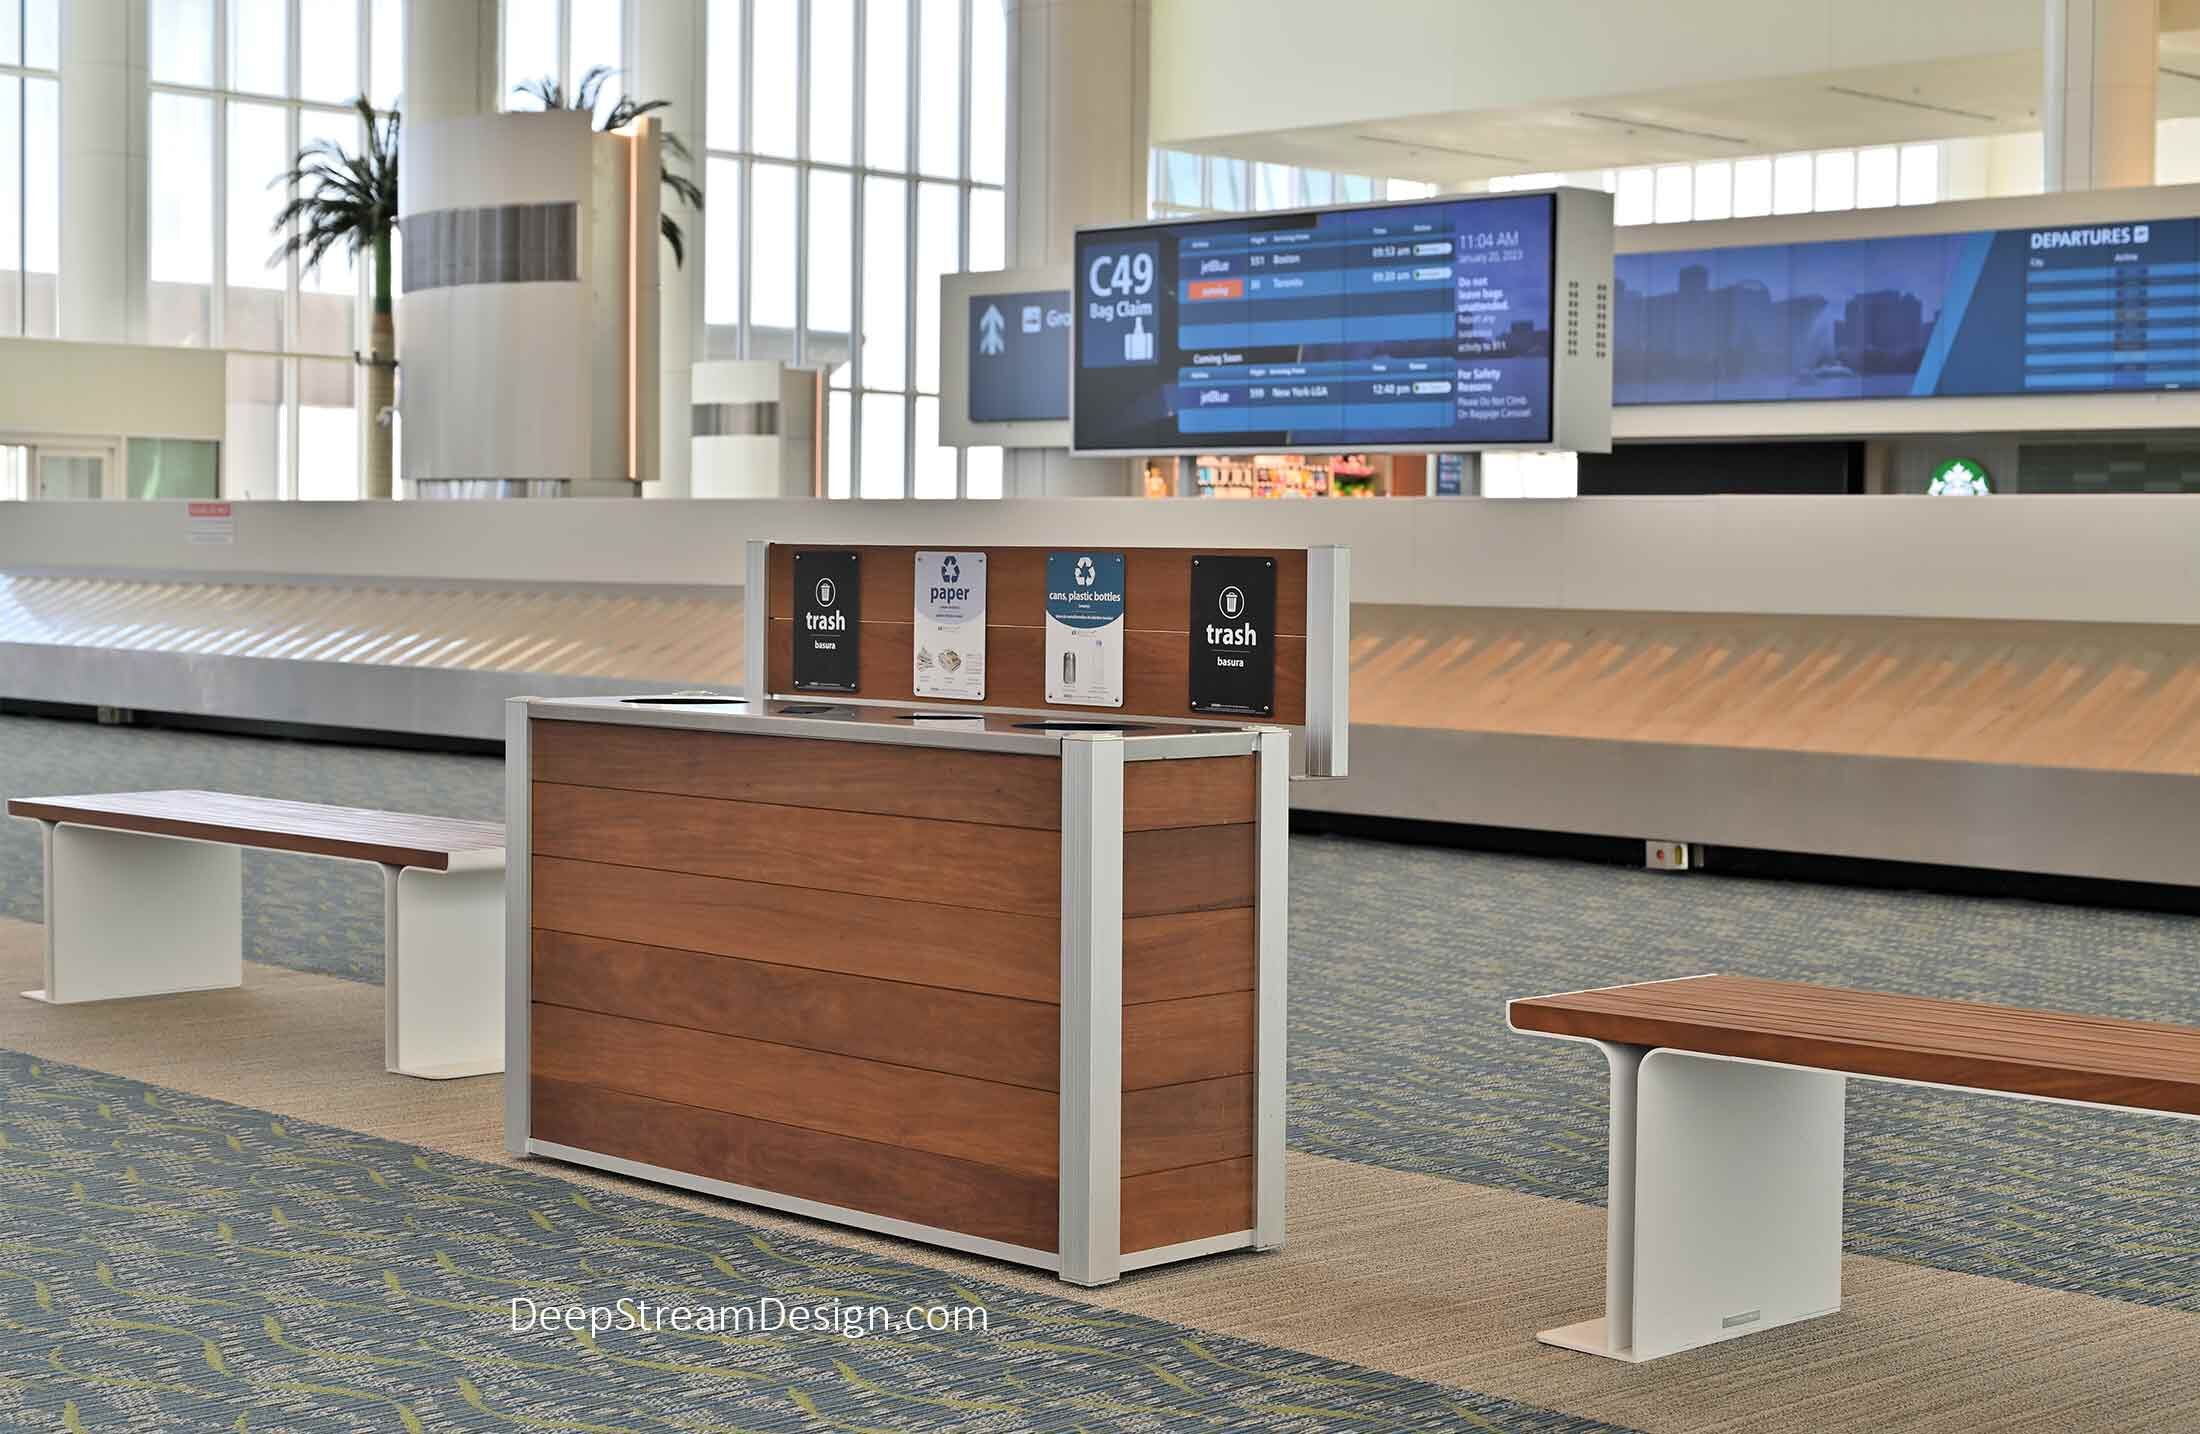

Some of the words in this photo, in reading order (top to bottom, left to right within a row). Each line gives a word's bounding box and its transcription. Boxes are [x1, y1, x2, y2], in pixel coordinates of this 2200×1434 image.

[1460, 232, 1494, 249] 11:04
[1496, 230, 1520, 247] AM
[2031, 226, 2131, 250] DEPARTURES
[1089, 253, 1154, 297] C49
[1090, 303, 1116, 323] Bag
[1117, 299, 1153, 317] Claim
[1193, 353, 1223, 367] Coming
[1223, 352, 1244, 363] Soon
[930, 587, 970, 604] paper
[1049, 592, 1068, 602] cans,
[1068, 590, 1093, 603] plastic
[1094, 591, 1121, 602] bottles
[806, 610, 846, 631] trash
[1206, 622, 1257, 646] trash
[814, 640, 836, 650] basura
[1217, 656, 1244, 668] basura
